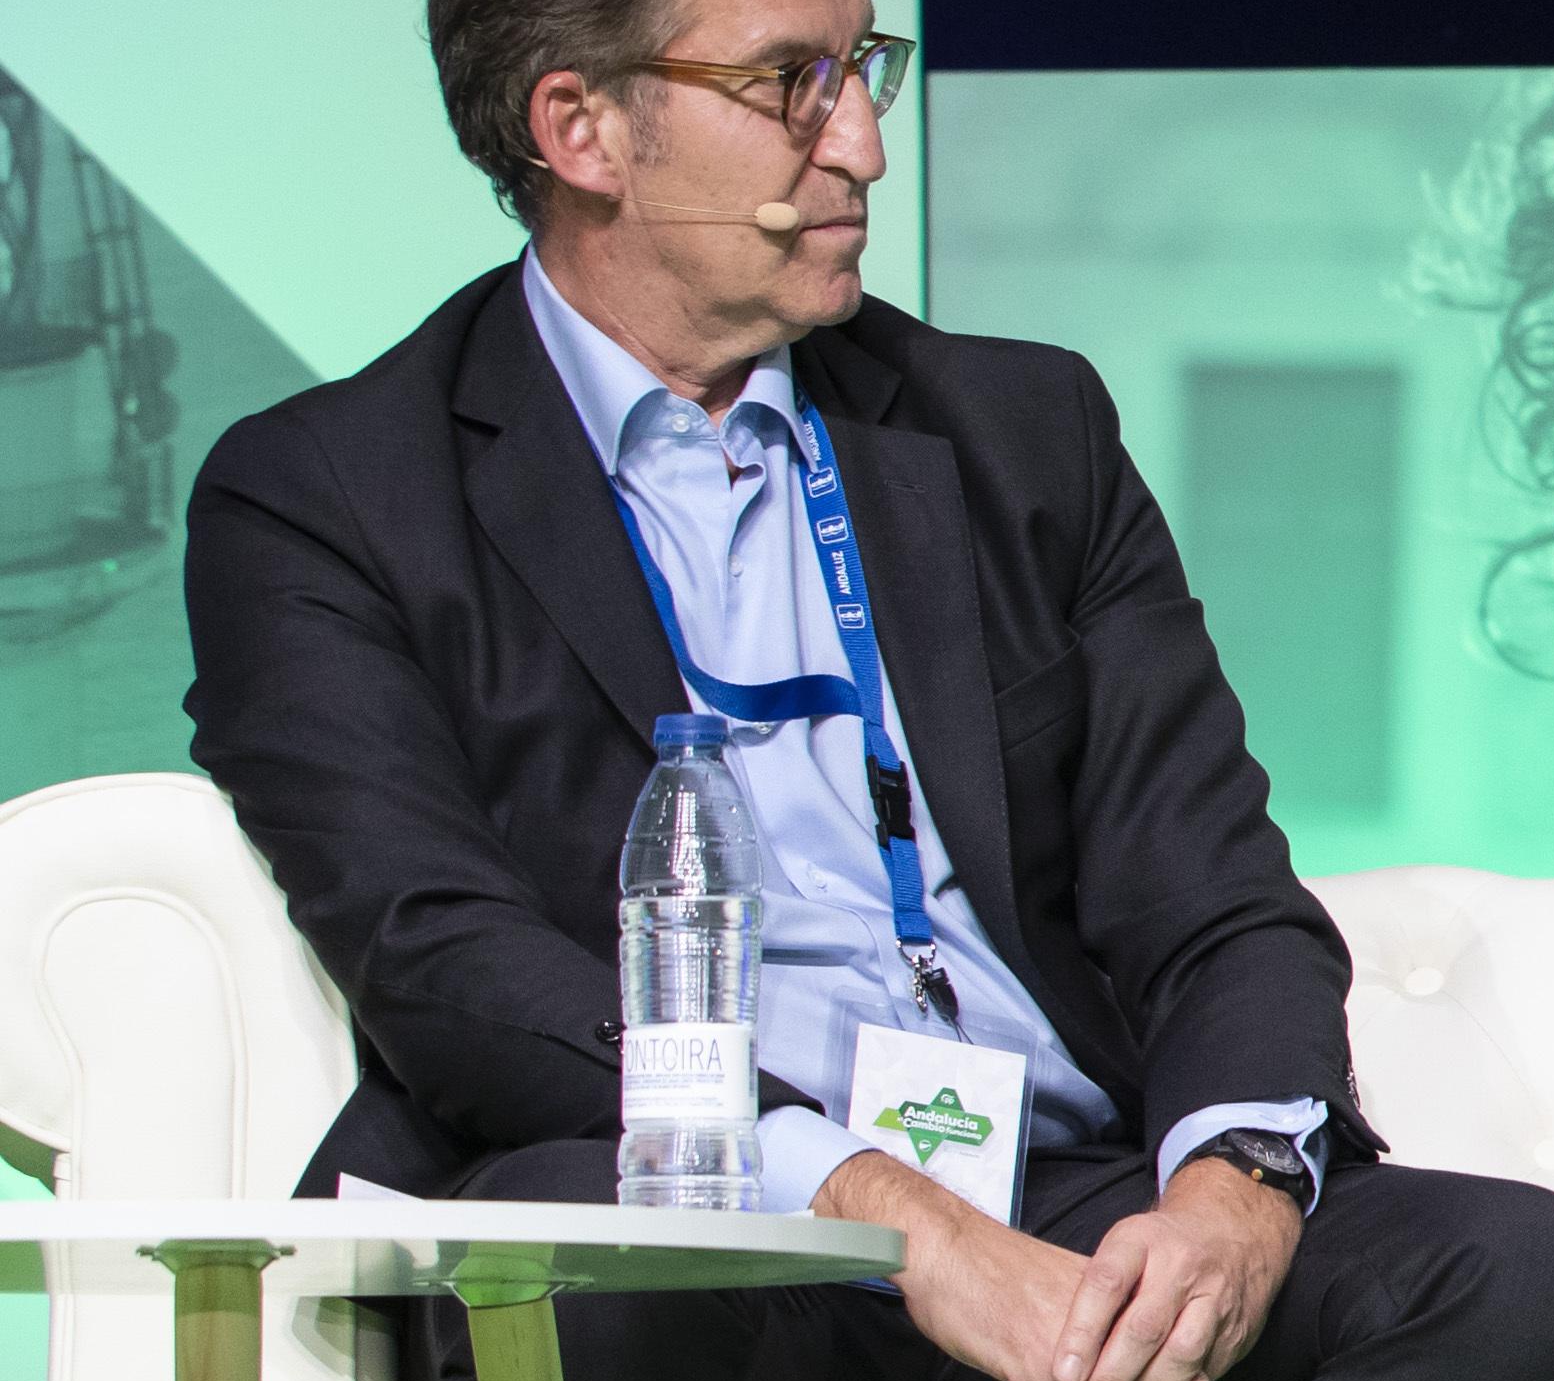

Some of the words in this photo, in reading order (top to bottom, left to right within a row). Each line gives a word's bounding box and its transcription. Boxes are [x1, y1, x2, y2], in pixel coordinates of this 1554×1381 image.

[831, 550, 852, 595] ANDALUZ
[903, 1118, 945, 1133] Cambio
[904, 1106, 978, 1130] Andalucía
